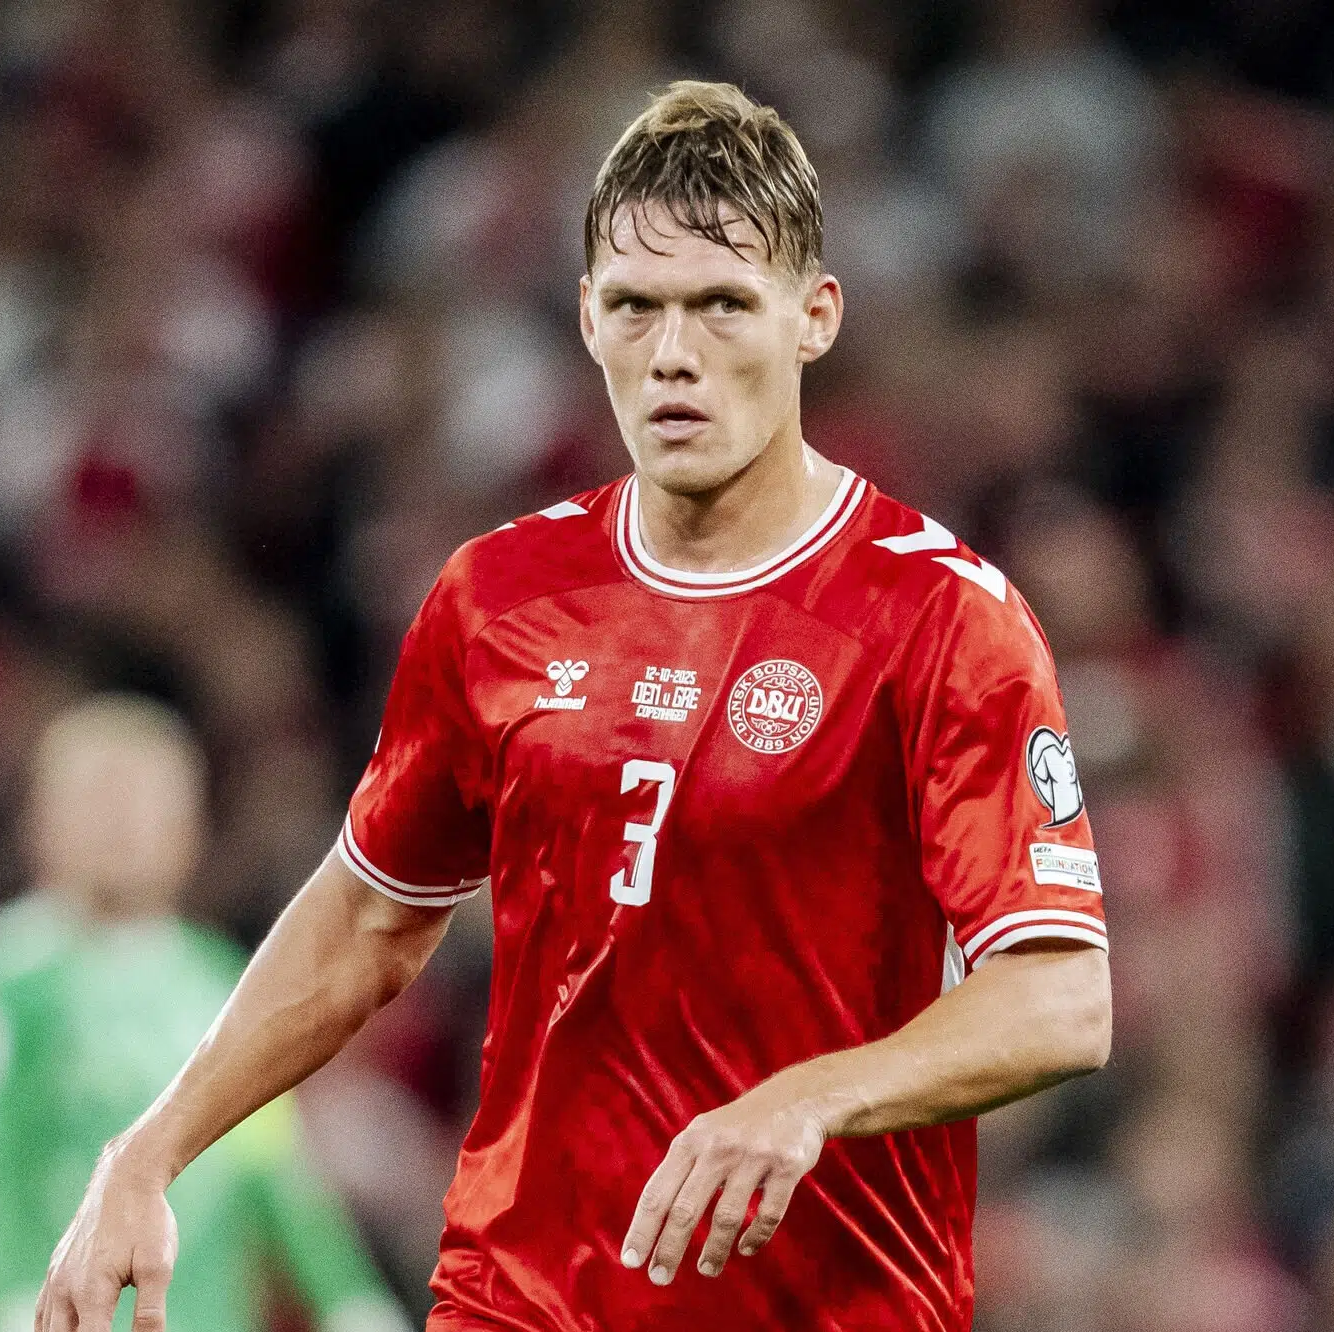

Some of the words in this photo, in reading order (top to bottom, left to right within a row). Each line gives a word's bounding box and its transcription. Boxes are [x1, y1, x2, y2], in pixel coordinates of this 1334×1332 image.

[645, 665, 698, 685] 12-10-2025
[533, 695, 588, 711] hummel
[631, 681, 662, 706] DEN
[672, 686, 702, 710] GRE
[746, 687, 805, 723] DBU
[731, 678, 752, 734] DANSK
[789, 696, 820, 744] UNION
[746, 733, 785, 750] 1889
[609, 758, 676, 907] 3
